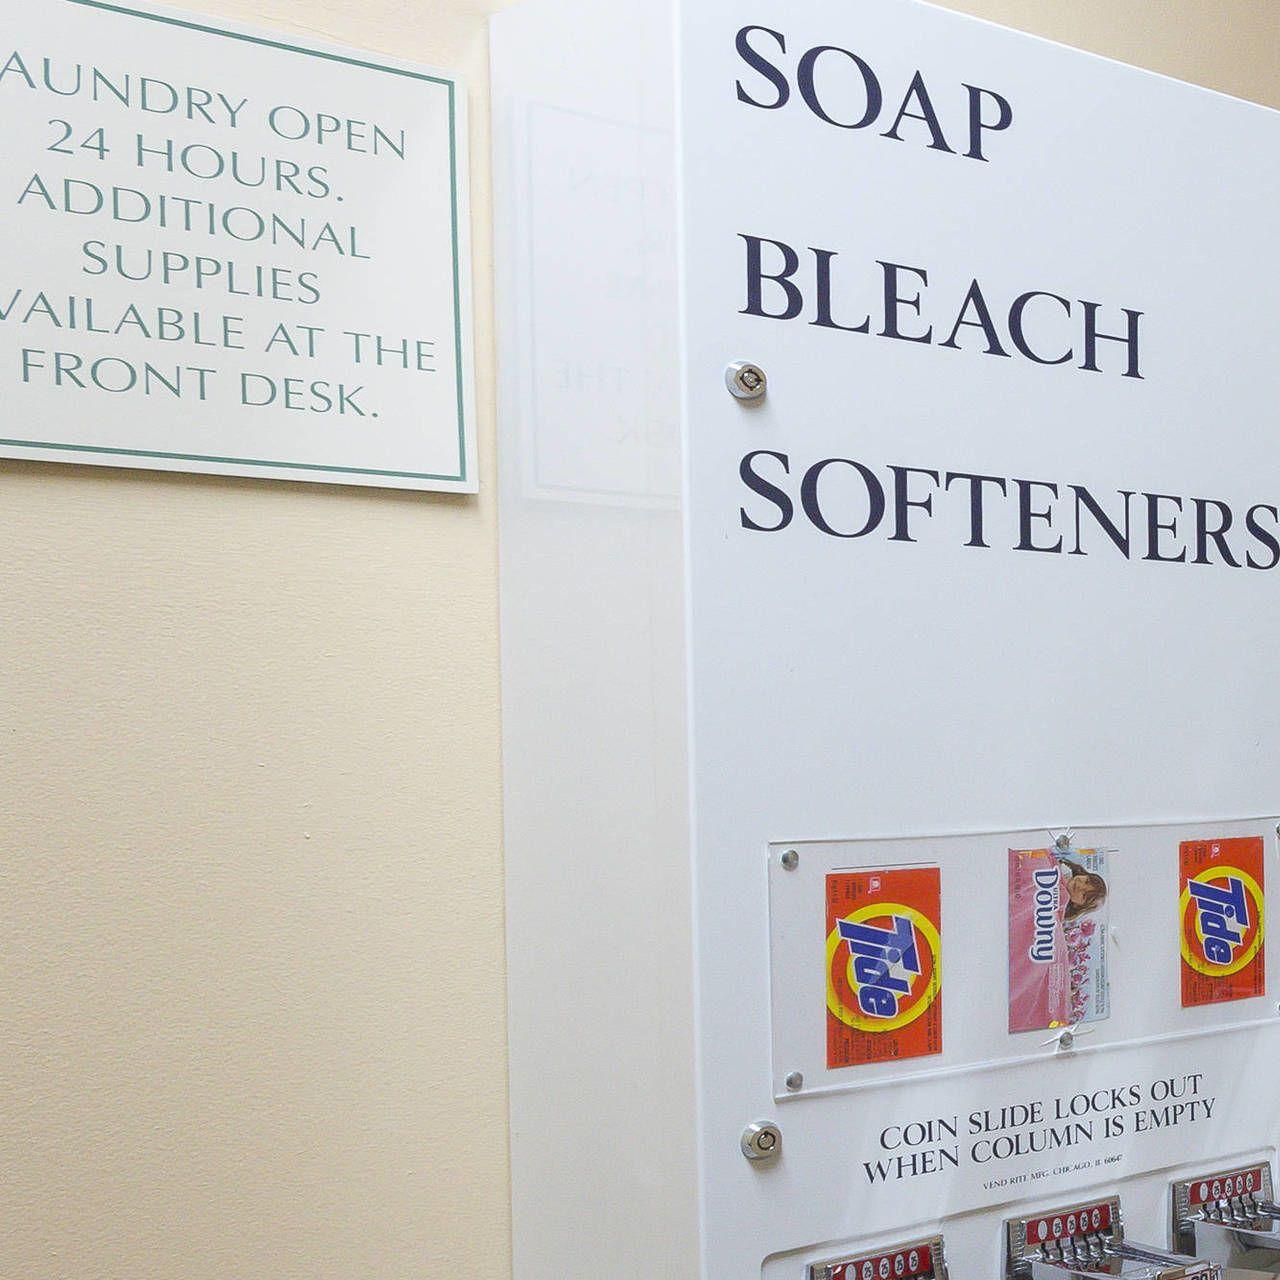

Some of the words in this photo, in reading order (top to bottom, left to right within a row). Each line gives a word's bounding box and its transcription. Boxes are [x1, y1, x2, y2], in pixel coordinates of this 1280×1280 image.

[268, 105, 406, 160] OPEN
[735, 25, 1013, 162] SOAP
[46, 119, 110, 160] 24
[136, 133, 344, 202] HOURS.
[17, 173, 371, 259] ADDITIONAL
[82, 240, 321, 305] SUPPLIES
[737, 233, 1145, 380] BLEACH
[21, 348, 216, 401] FRONT
[241, 372, 380, 418] DESK.
[265, 322, 324, 359] AT
[343, 331, 437, 373] THE
[739, 449, 1280, 570] SOFTENERS
[1029, 867, 1060, 964] Downy
[1186, 876, 1249, 966] Tide
[835, 914, 922, 1019] Tide
[863, 1145, 960, 1185] WHEN
[971, 1120, 1093, 1164] COLUMN
[1104, 1114, 1125, 1138] IS
[1134, 1098, 1216, 1133] EMPTY
[880, 1116, 959, 1150] COIN
[968, 1101, 1044, 1135] SLIDE
[1054, 1083, 1142, 1120] LOCKS
[1150, 1073, 1203, 1101] OUT
